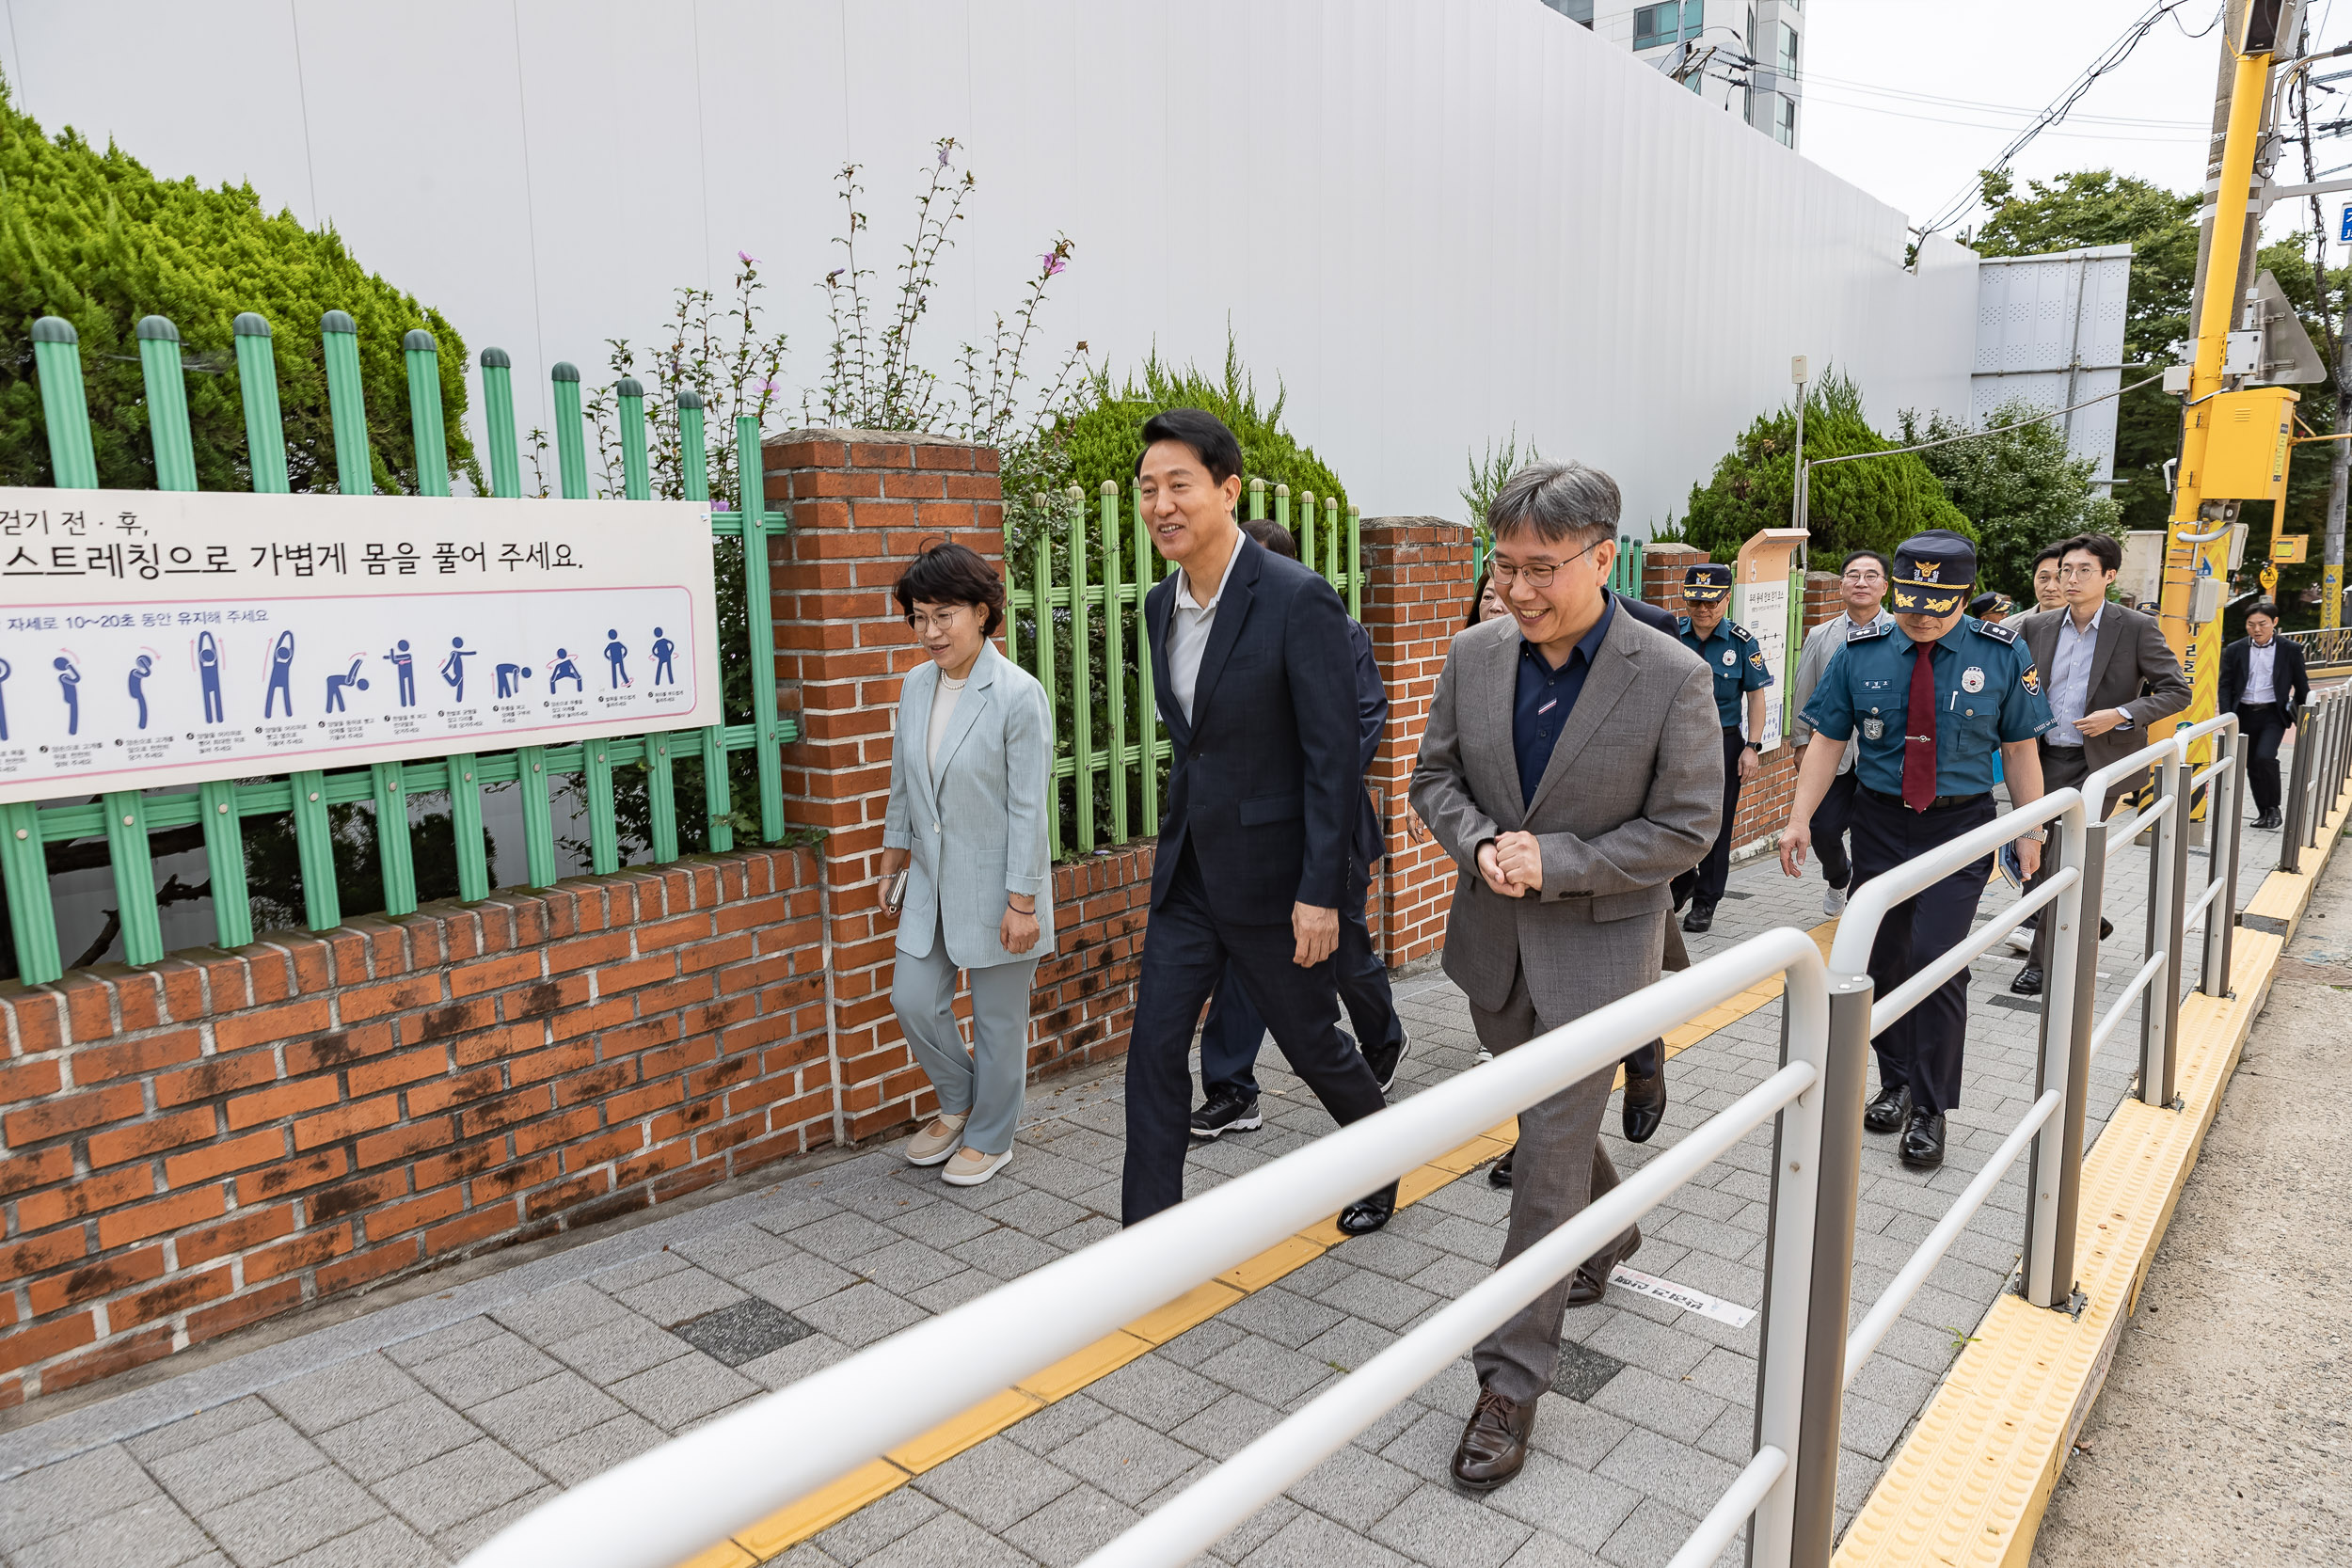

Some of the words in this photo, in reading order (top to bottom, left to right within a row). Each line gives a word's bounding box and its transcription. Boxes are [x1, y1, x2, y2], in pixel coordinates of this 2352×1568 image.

[0, 510, 48, 535] 걷기
[61, 511, 86, 536] 전
[116, 512, 149, 536] 후,
[2, 543, 237, 579] 스트레칭으로
[249, 542, 347, 577] 가볍게
[360, 542, 421, 576] 몸을
[431, 541, 487, 574] 풀어
[497, 541, 584, 573] 주세요.
[1750, 560, 1758, 582] 5
[8, 615, 59, 631] 자세로
[66, 613, 136, 629] 10~20초
[141, 612, 171, 627] 동안
[177, 610, 222, 626] 유지해
[227, 610, 269, 625] 주세요
